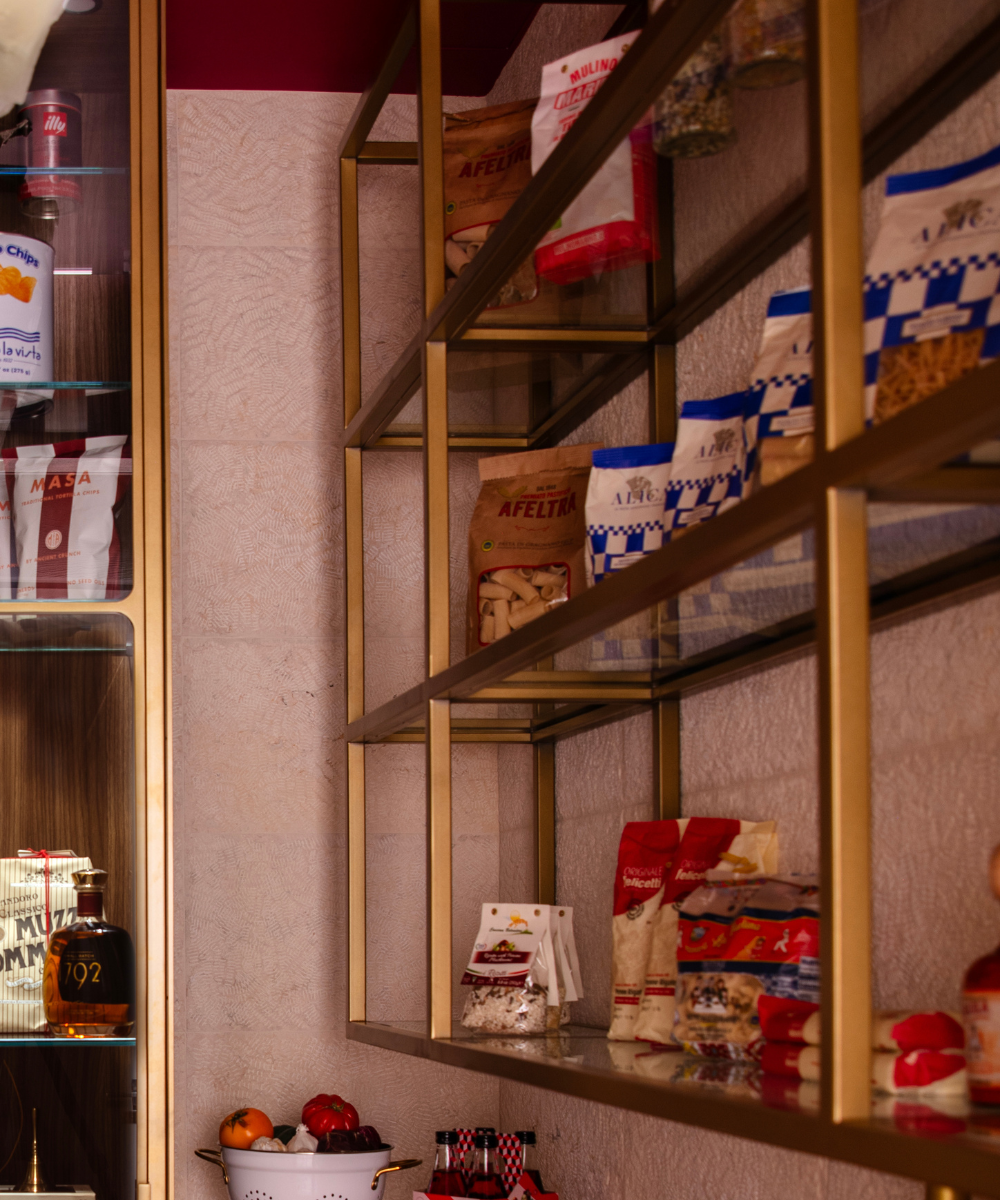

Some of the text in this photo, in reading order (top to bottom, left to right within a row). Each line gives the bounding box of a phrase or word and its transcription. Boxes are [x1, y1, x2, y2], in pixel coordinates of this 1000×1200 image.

[570, 57, 618, 84] MULINO
[557, 78, 604, 107] MARI
[44, 115, 66, 134] illy
[6, 244, 39, 268] Chips
[3, 341, 13, 356] la
[15, 345, 41, 360] vista
[30, 470, 91, 494] MASA
[21, 496, 54, 507] TRADITIONAL
[55, 492, 81, 500] TORTILLA
[498, 492, 576, 518] AFELTRA
[34, 554, 57, 563] ANCIENT
[58, 551, 81, 559] CRUNCH
[624, 866, 663, 876] ORIGINALE
